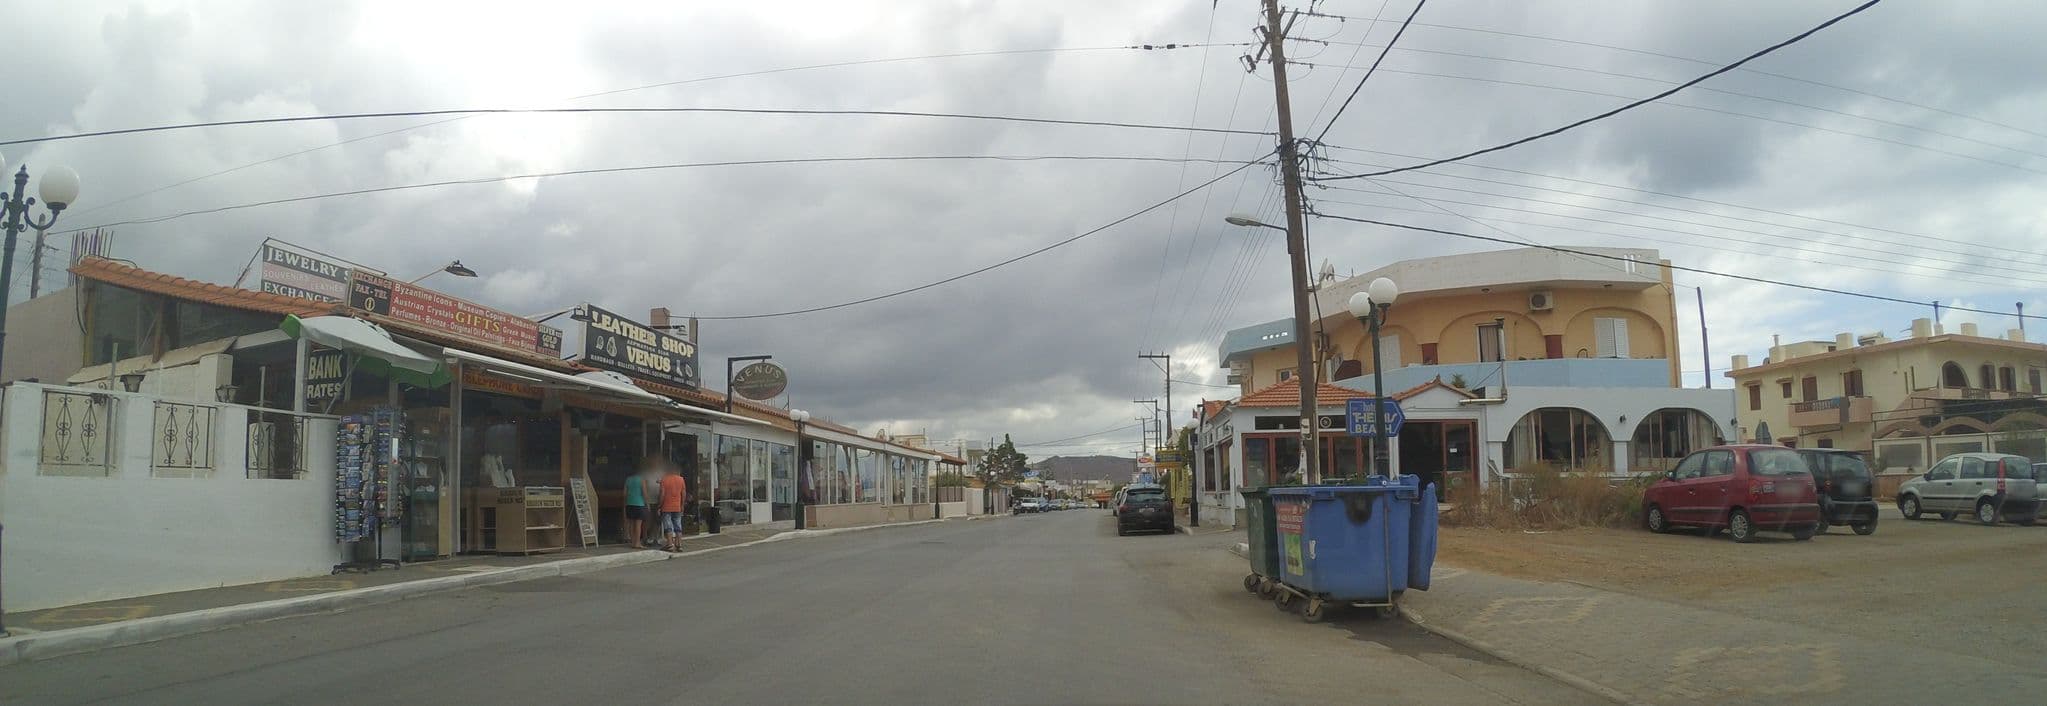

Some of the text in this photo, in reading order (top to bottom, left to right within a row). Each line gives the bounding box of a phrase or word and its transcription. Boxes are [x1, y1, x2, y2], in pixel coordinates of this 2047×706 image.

[266, 247, 339, 278] JEWELRY
[393, 296, 454, 320] Austrian Crystals
[395, 283, 433, 302] Byzantine
[433, 296, 453, 307] Icons
[457, 302, 485, 316] Museum
[485, 310, 506, 323] Copies
[391, 307, 421, 321] Perfumes
[425, 315, 446, 328] Bronze
[450, 322, 473, 335] Original
[473, 325, 481, 336] Oil
[481, 329, 505, 343] Paintings
[455, 311, 500, 333] GIFTS
[502, 326, 536, 341] Greek Music
[591, 310, 694, 358] LEATHER SHOP
[542, 333, 558, 345] GOLD
[308, 354, 343, 380] BANK
[626, 345, 672, 373] VENUS
[736, 364, 782, 382] VENUS
[306, 382, 342, 399] RATES
[1355, 423, 1392, 434] BEAH
